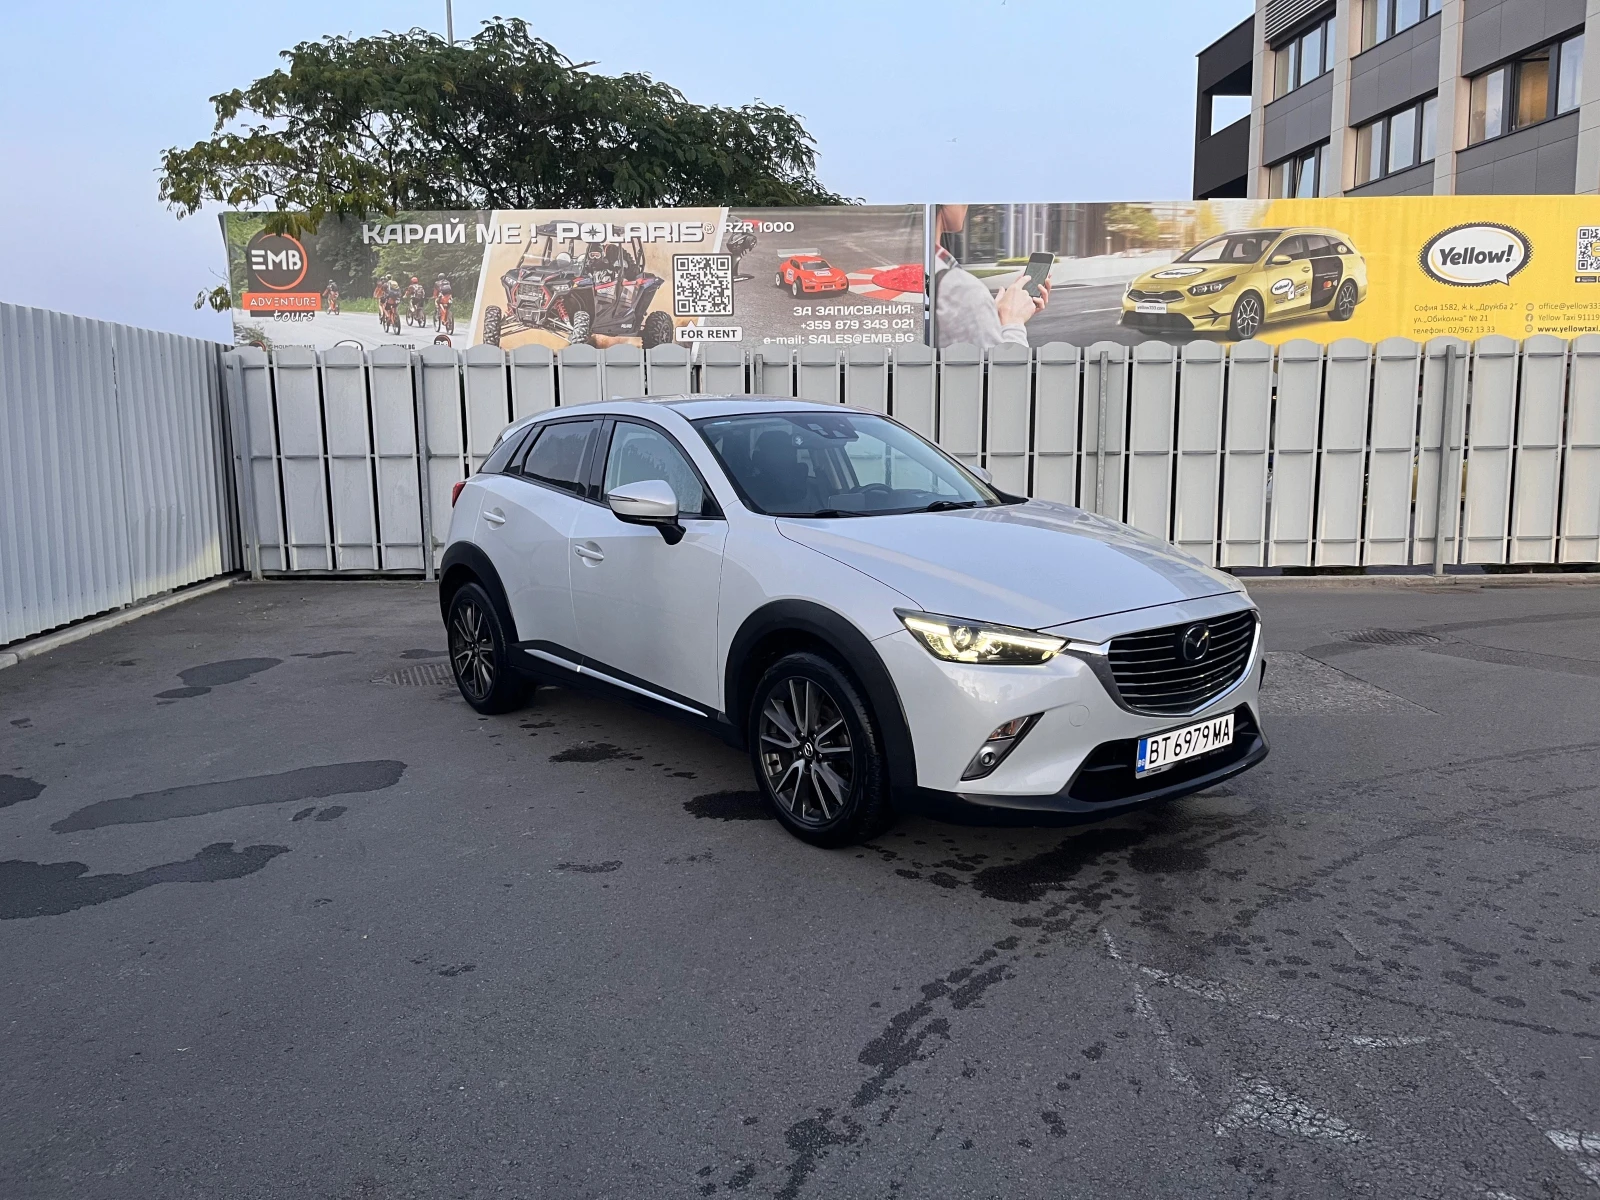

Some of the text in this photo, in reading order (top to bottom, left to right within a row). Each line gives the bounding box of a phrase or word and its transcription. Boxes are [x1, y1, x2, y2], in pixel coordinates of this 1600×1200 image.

[362, 217, 466, 245] КАРАЙ
[476, 223, 522, 244] МЕ
[725, 221, 795, 234] RZR 1000
[251, 250, 302, 270] EMB
[1439, 244, 1514, 266] Yellow!
[250, 297, 316, 306] ADVENTURE
[793, 304, 914, 316] ЗА ЗАПИСВАНИЯ:
[1414, 304, 1438, 312] София
[274, 310, 314, 322] tours
[800, 318, 914, 330] +359 879 343 021
[681, 329, 738, 339] FOR RENT
[764, 333, 914, 345] e-mail: SALES@EMB.BG
[1149, 719, 1230, 764] BT 6979 MA
[1138, 759, 1145, 767] BG
